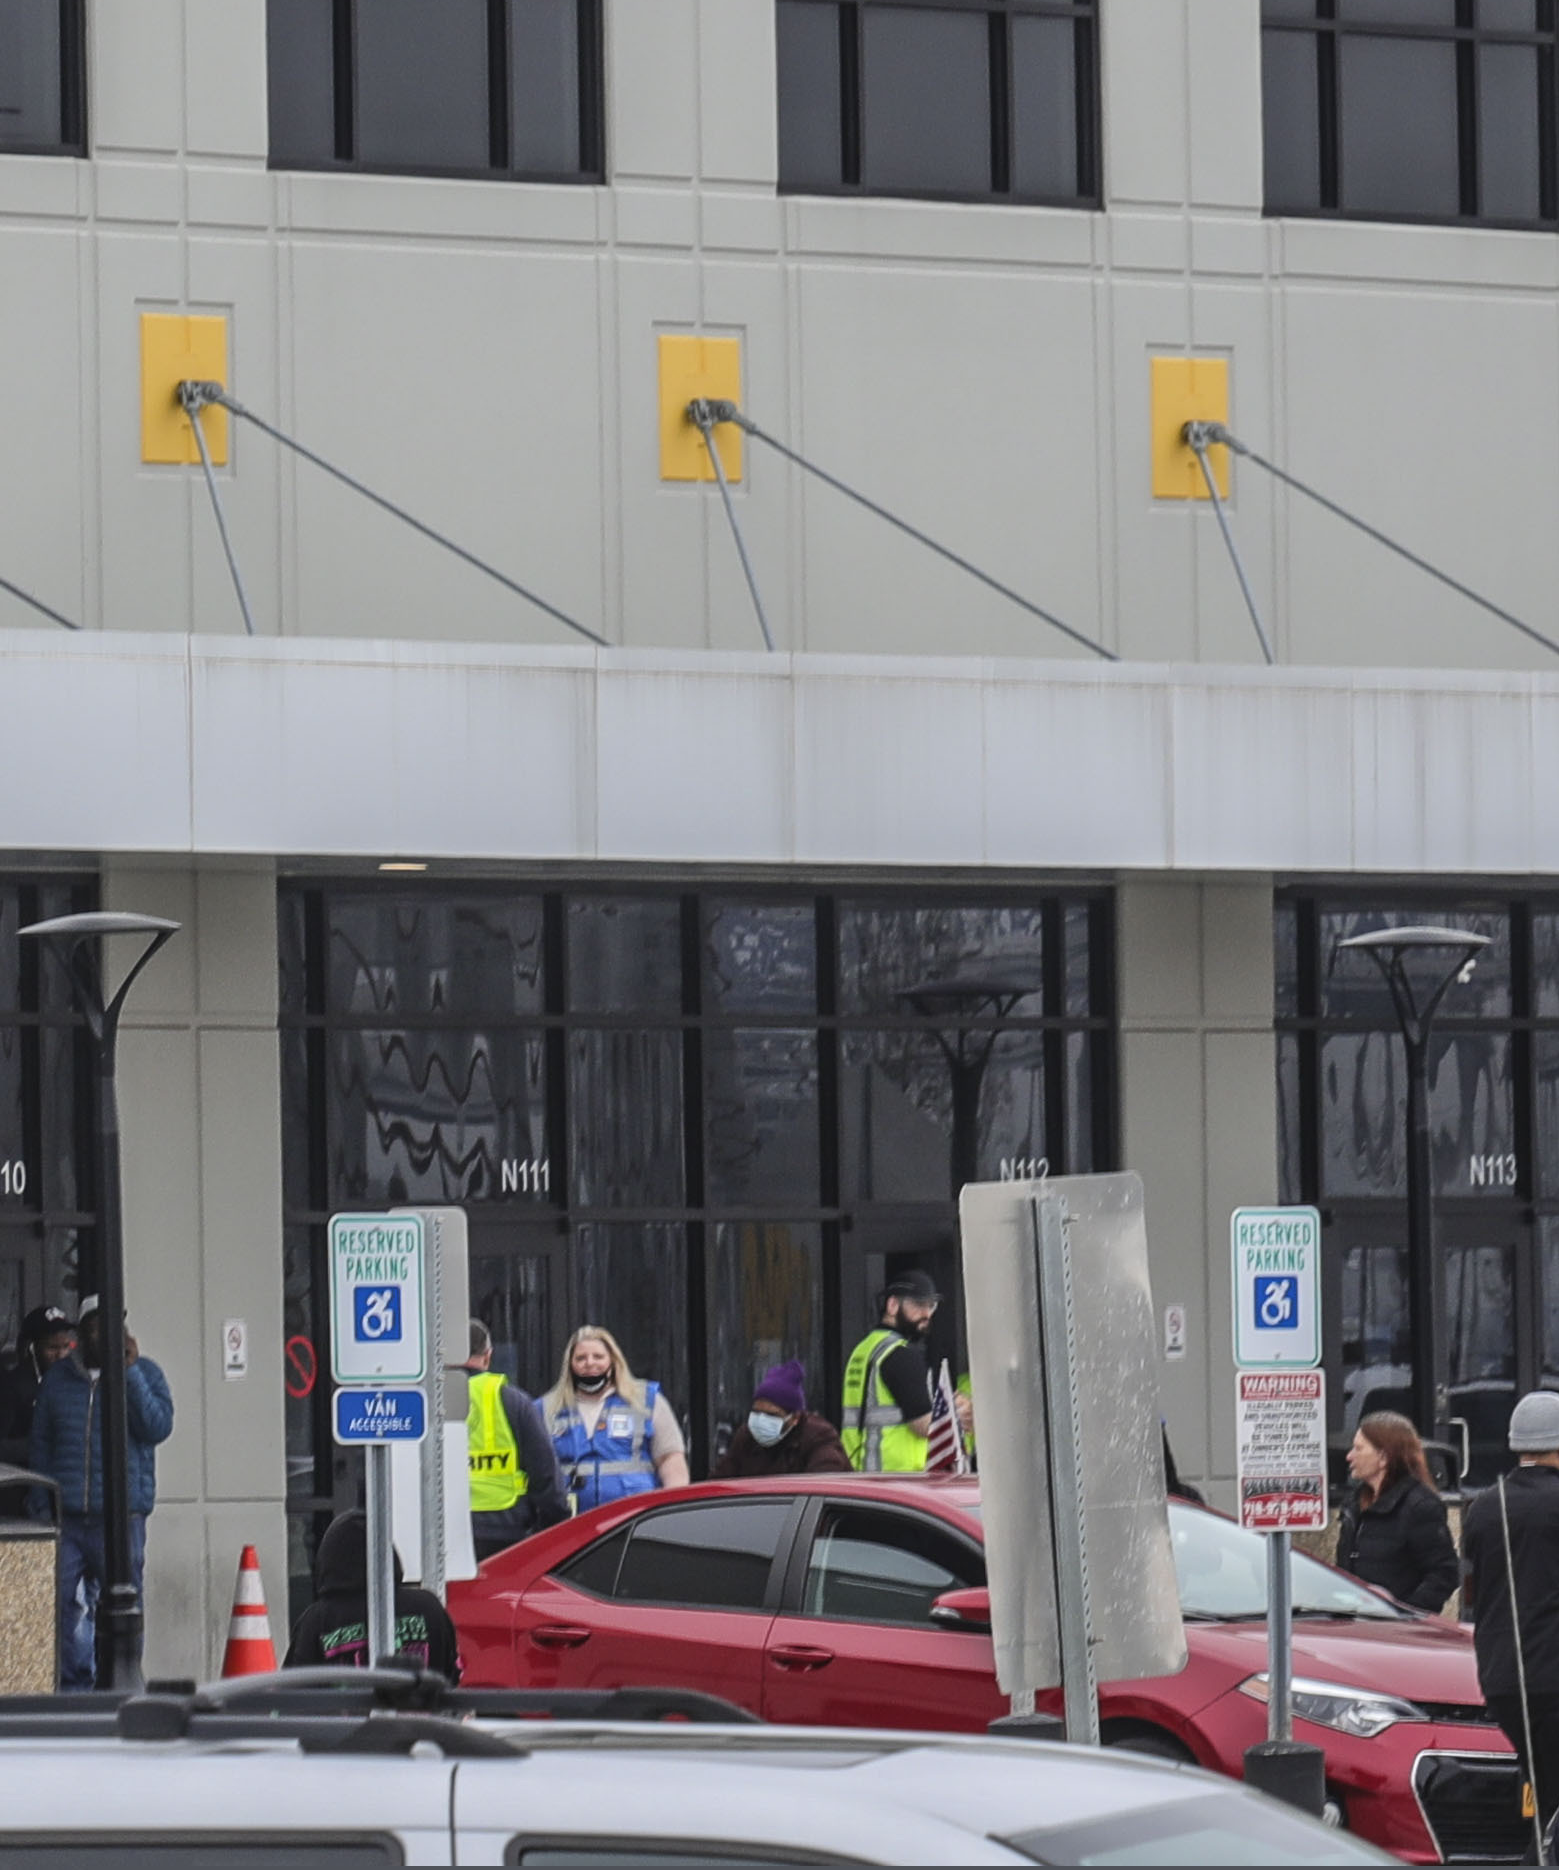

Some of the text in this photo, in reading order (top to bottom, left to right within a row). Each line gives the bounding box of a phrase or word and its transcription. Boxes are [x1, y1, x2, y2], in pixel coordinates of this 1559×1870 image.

[502, 1158, 549, 1192] N111
[1000, 1157, 1049, 1182] N112
[1471, 1154, 1517, 1186] N113
[339, 1230, 414, 1253] RESERVED
[1240, 1222, 1311, 1245] RESERVED
[346, 1255, 408, 1281] PARKING
[1246, 1247, 1304, 1271] PARKING
[1243, 1376, 1318, 1391] WARNING
[364, 1398, 397, 1417] VAN
[349, 1416, 412, 1431] ACCESSIBLE
